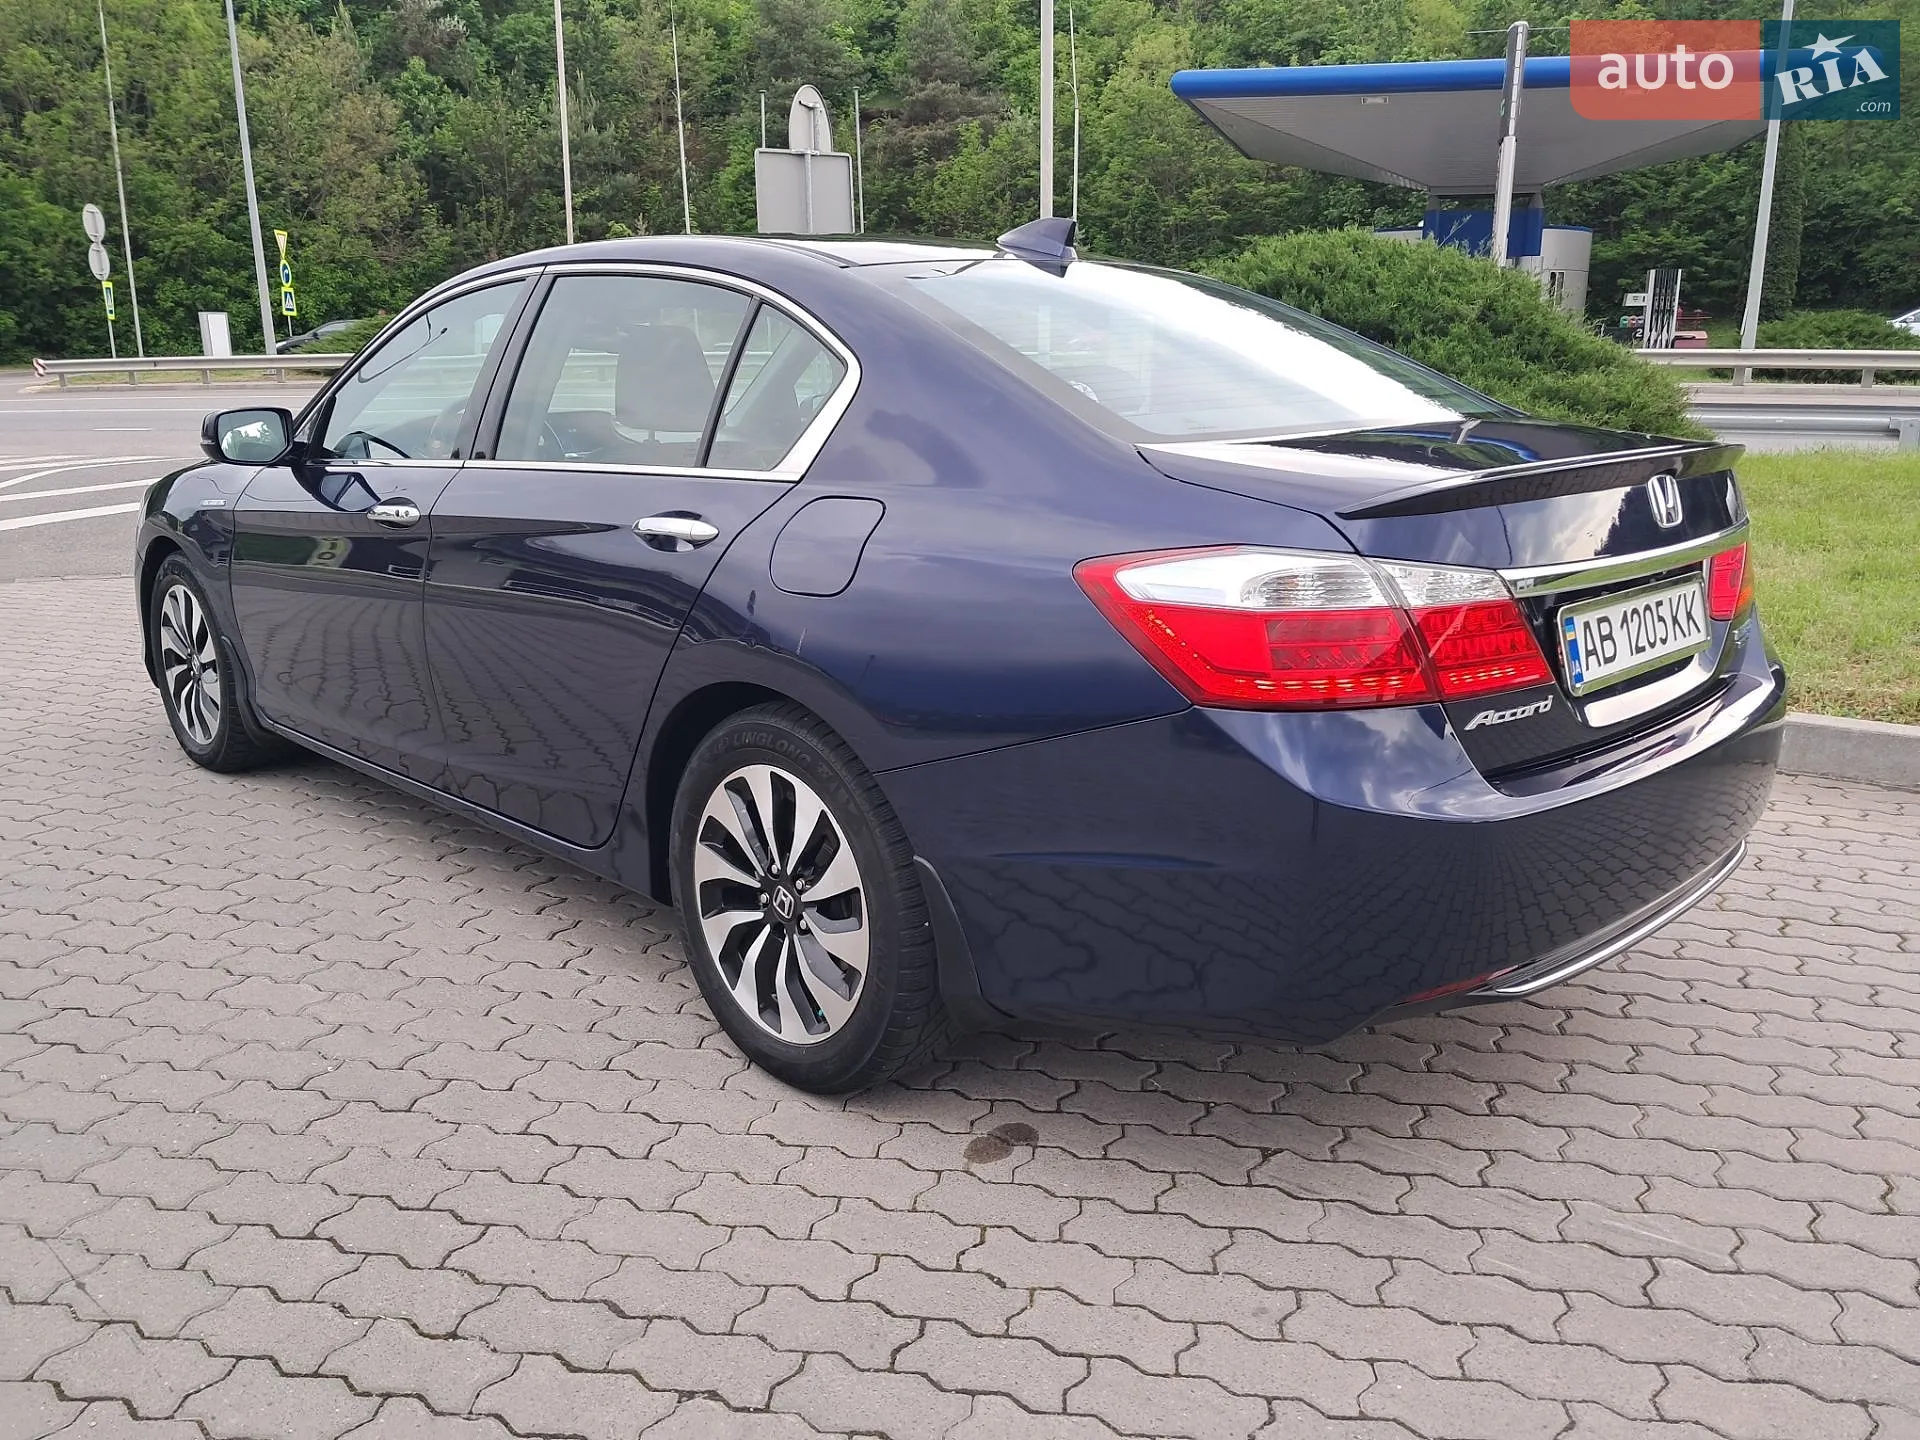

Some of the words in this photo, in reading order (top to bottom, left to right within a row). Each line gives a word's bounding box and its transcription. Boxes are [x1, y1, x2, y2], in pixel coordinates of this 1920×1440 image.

[1582, 616, 1617, 671] AB
[1620, 600, 1668, 657] 1205
[1668, 590, 1701, 641] KK
[1463, 694, 1554, 731] Accord
